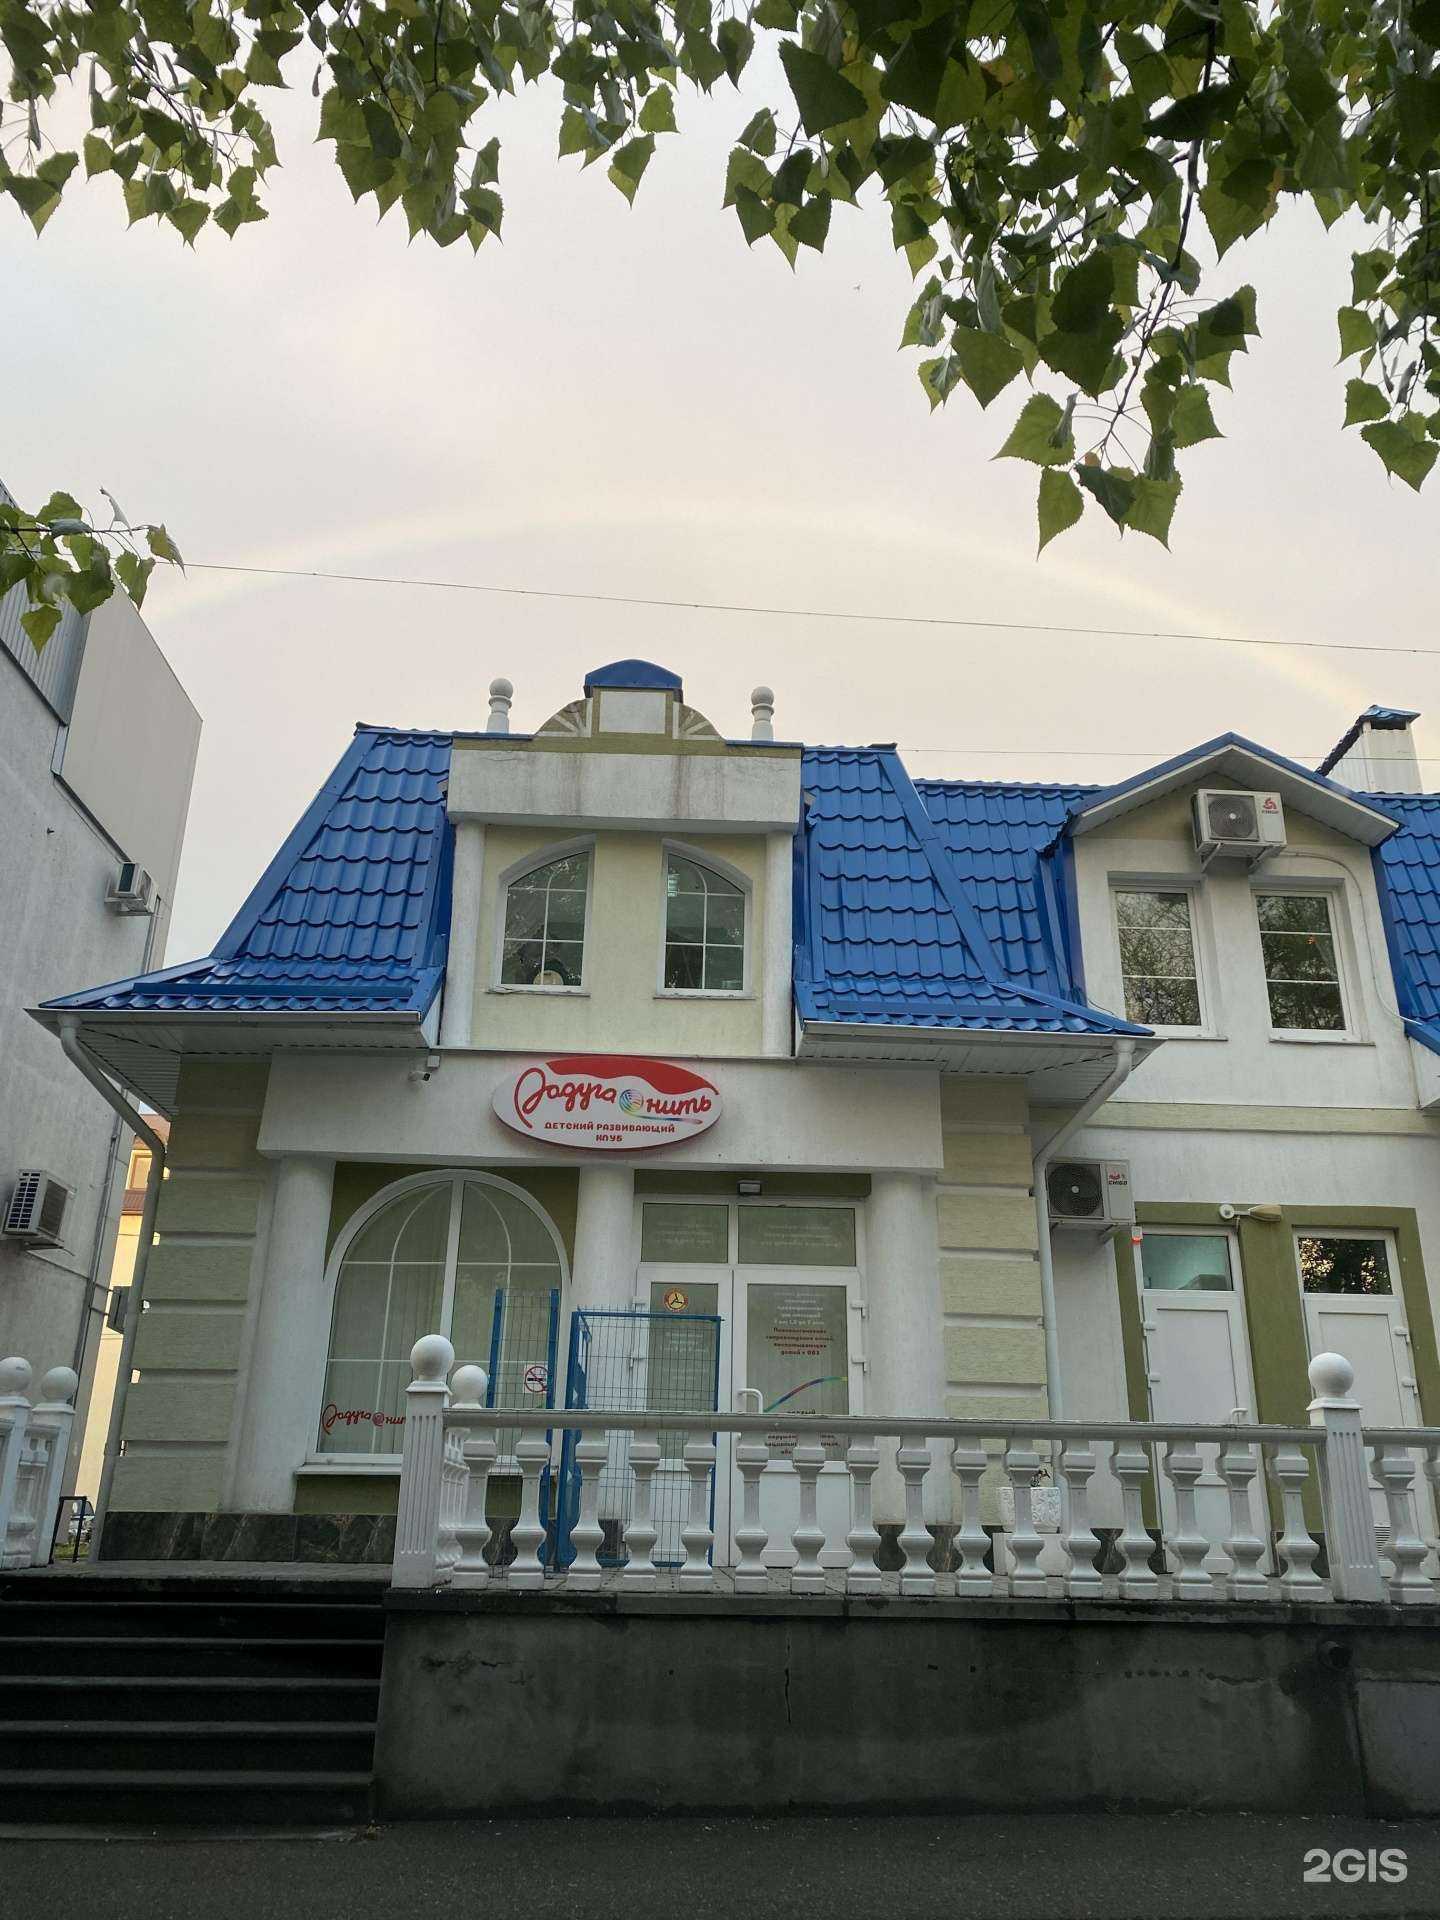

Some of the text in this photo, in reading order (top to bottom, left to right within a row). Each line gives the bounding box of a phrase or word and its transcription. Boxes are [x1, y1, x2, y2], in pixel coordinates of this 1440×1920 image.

[544, 1121, 675, 1134] ДЕТСКИЙ РАЗВИВАЮЩИЙ
[595, 1134, 623, 1142] КЛУБ
